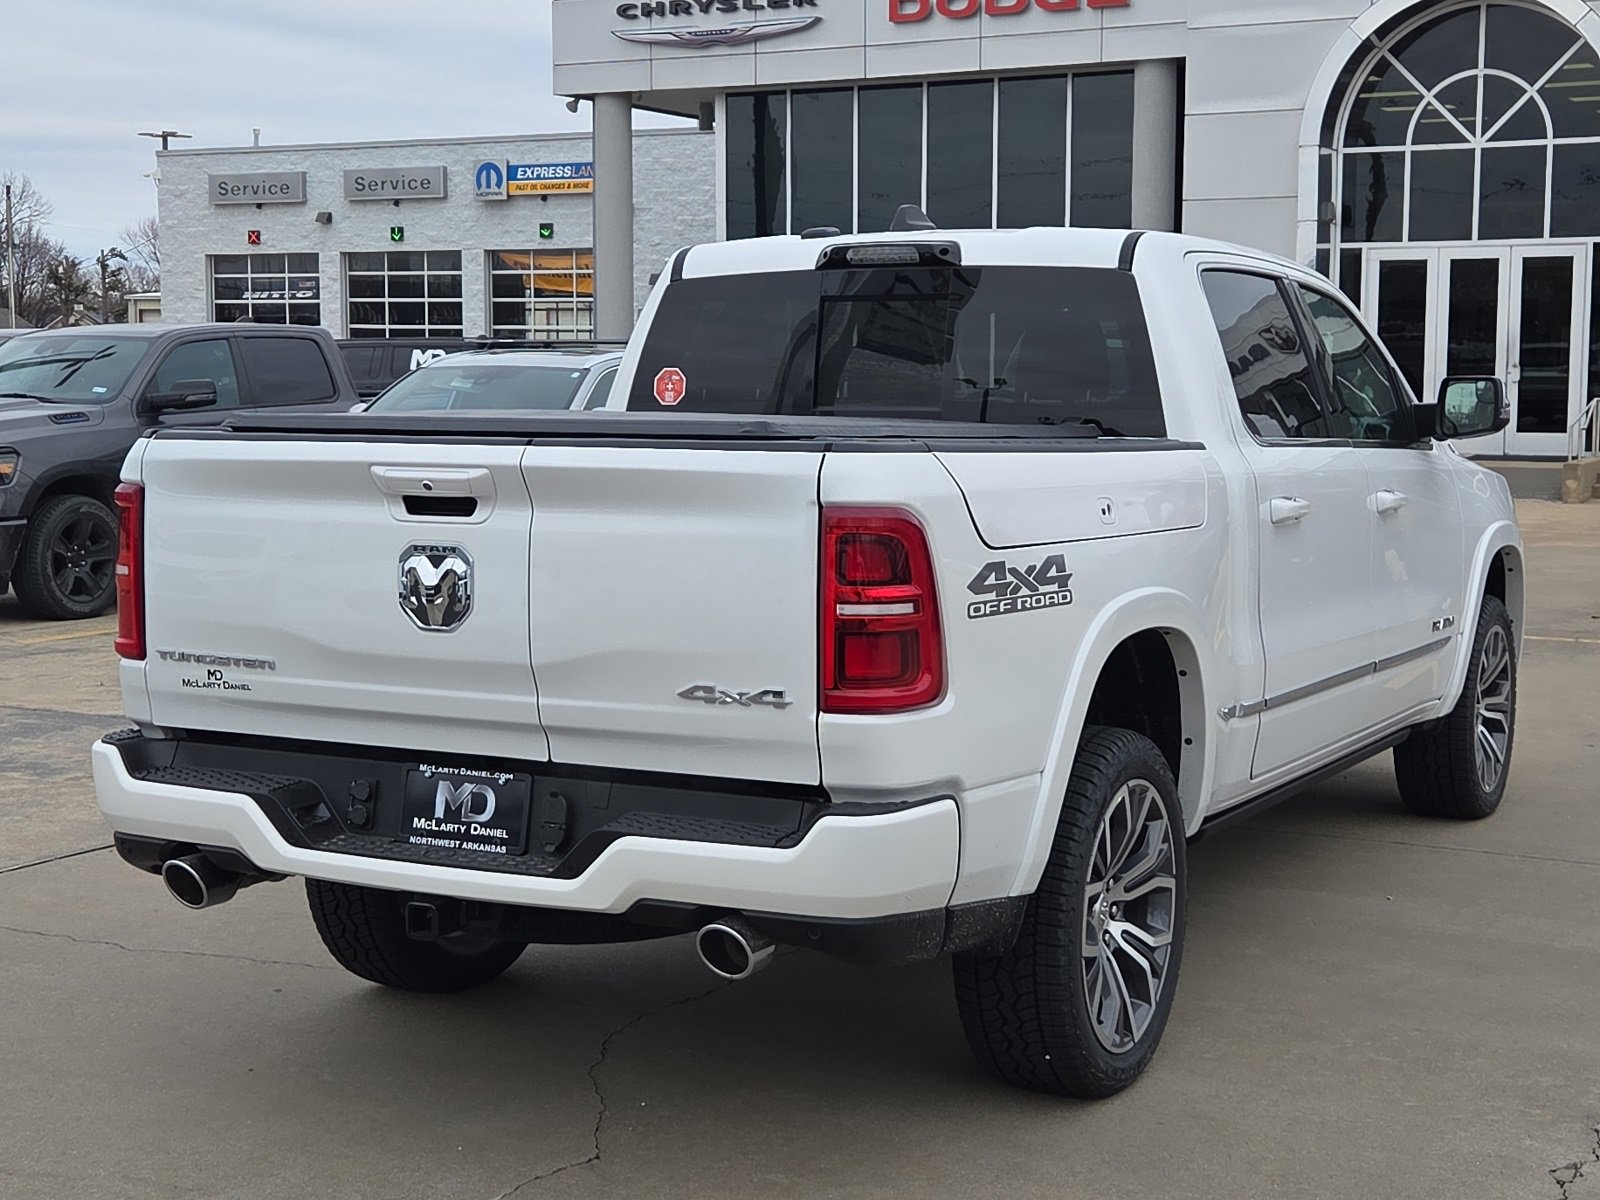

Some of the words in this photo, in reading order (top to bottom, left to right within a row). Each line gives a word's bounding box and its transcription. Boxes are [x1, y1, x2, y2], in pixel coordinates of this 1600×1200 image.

[218, 180, 290, 196] Service
[354, 175, 431, 192] Service
[540, 182, 566, 190] CHANGES
[413, 545, 457, 554] RAM
[969, 600, 1013, 617] OFF
[1017, 591, 1072, 610] ROAD
[434, 780, 496, 822] MD
[409, 836, 460, 848] NORTHWEST
[462, 842, 507, 854] ARKANSAS
